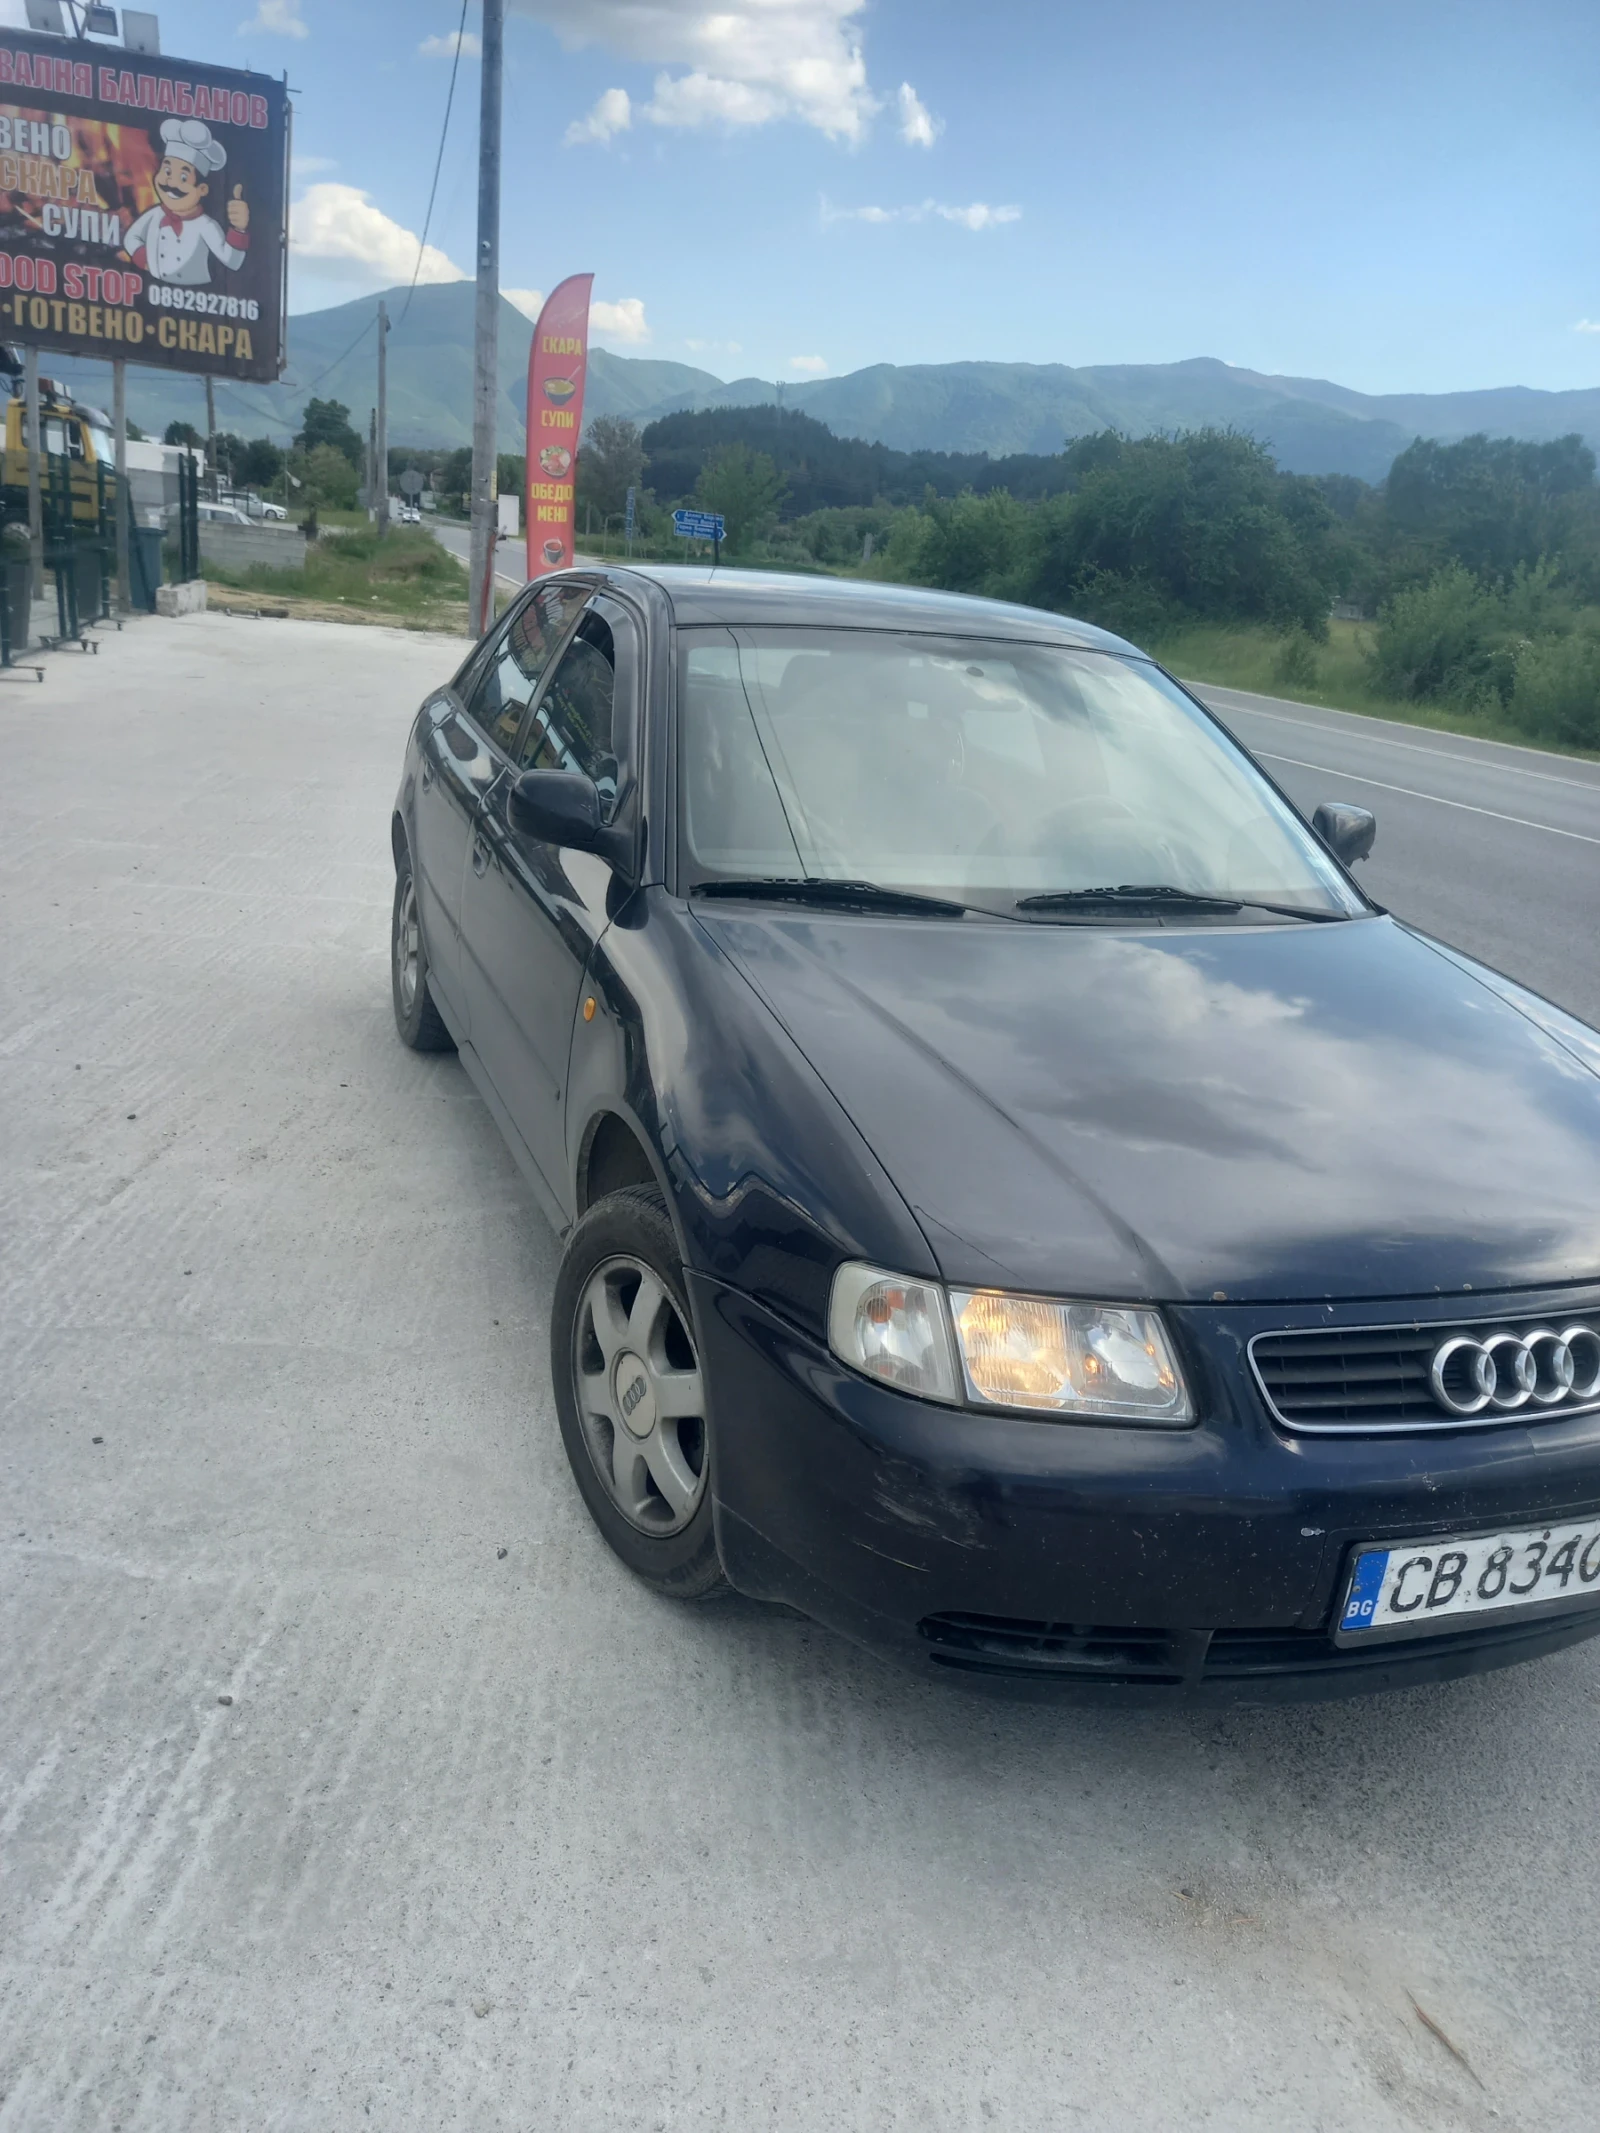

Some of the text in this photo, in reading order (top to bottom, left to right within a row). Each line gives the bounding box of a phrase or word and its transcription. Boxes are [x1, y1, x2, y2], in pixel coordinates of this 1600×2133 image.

[98, 66, 268, 129] БАЛАБАНОВ
[0, 155, 99, 206] СКАРА
[42, 203, 121, 247] СУПИ
[63, 263, 143, 307] STOP
[148, 284, 260, 321] 0892927816
[158, 316, 254, 360] СКАРА
[542, 336, 583, 356] СКАРА
[541, 410, 574, 428] СУПИ
[1389, 1551, 1468, 1613] CB
[1346, 1599, 1374, 1618] BG
